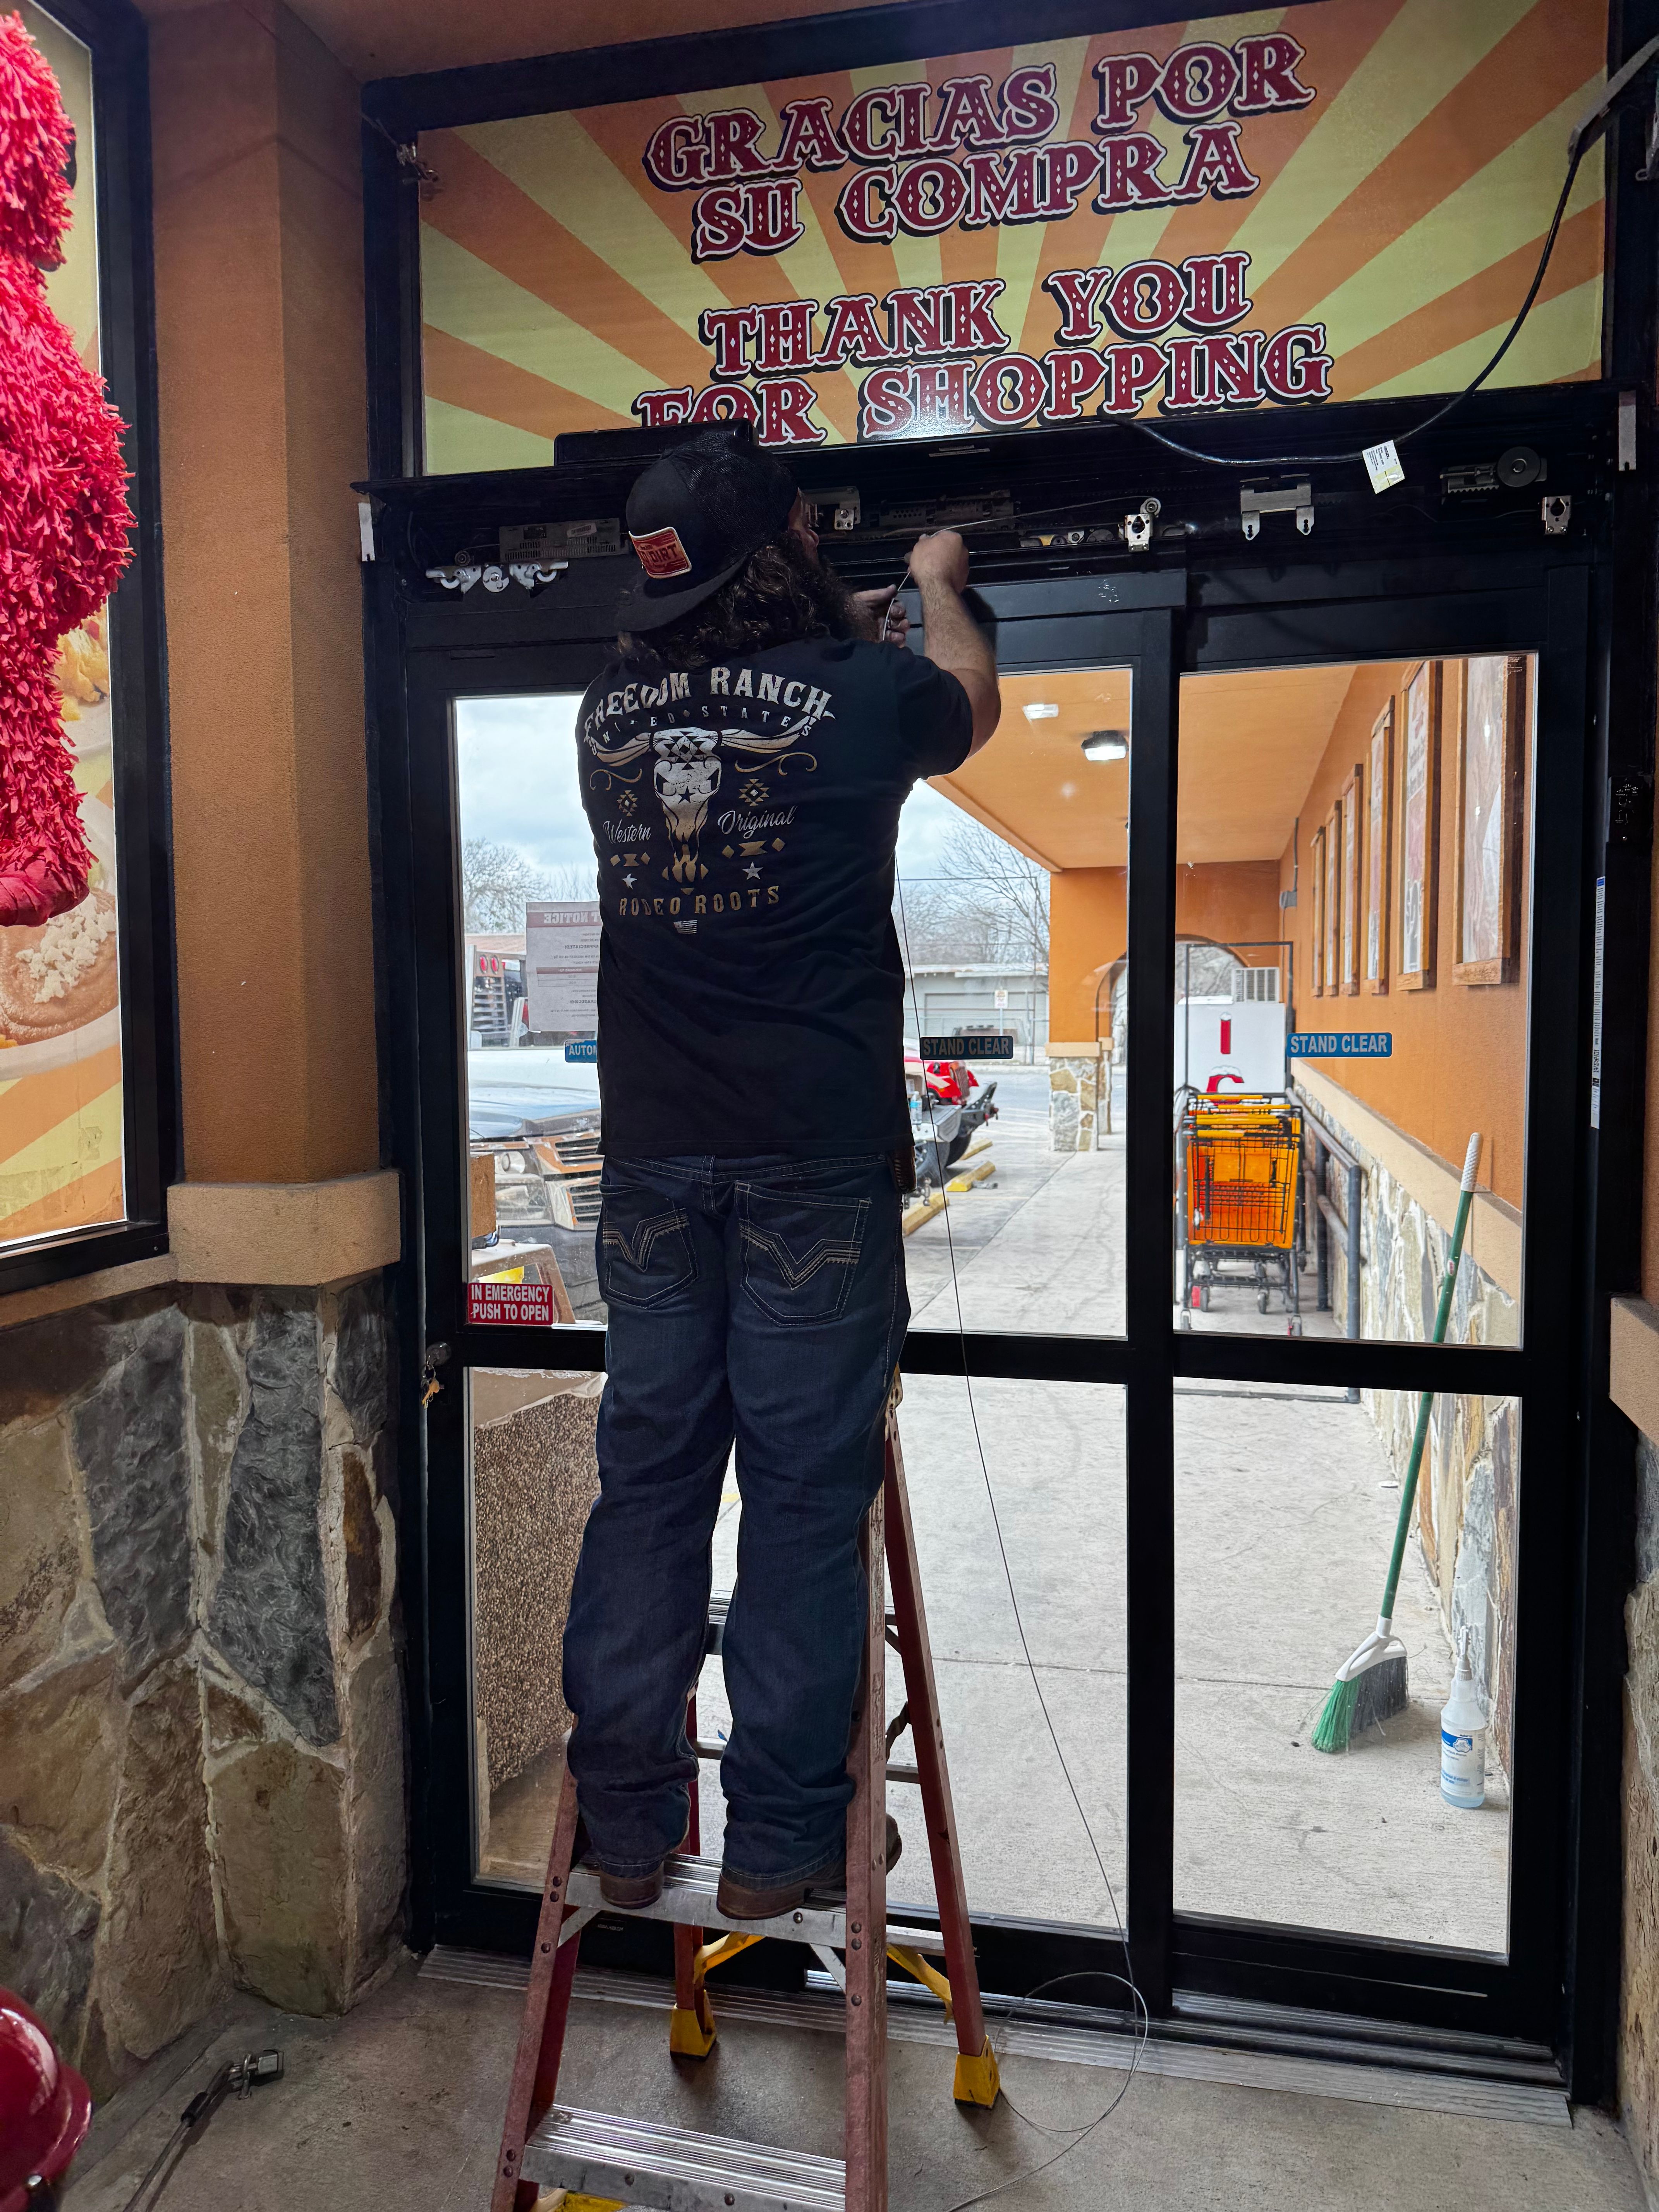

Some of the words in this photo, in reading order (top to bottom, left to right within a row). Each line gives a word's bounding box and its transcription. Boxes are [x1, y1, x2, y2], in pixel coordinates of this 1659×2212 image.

[648, 62, 1059, 187] GRACIAS
[1097, 34, 1315, 130] POR
[696, 179, 802, 259] SU
[841, 122, 1259, 239] COMPRA
[704, 279, 1009, 376] THANK
[1049, 252, 1252, 341] YOU
[637, 378, 826, 447] FOR
[864, 324, 1333, 438] SHOPPING
[584, 673, 692, 743] FREEDOM
[710, 667, 836, 720] RANCH
[591, 713, 675, 755] UNIED
[702, 706, 811, 737] STATES
[603, 819, 652, 844] Western
[718, 805, 798, 839] Original
[620, 897, 681, 915] RODEO
[695, 885, 779, 914] ROOTS
[923, 1039, 964, 1056] STAND
[968, 1037, 1010, 1055] CLEAR
[1291, 1036, 1337, 1054] STAND
[1342, 1035, 1387, 1053] CLEAR
[471, 1285, 482, 1300] IN
[486, 1285, 549, 1302] EMERGENCY
[473, 1303, 501, 1319] PUSH
[503, 1304, 518, 1320] TO
[520, 1304, 549, 1321] OPEN
